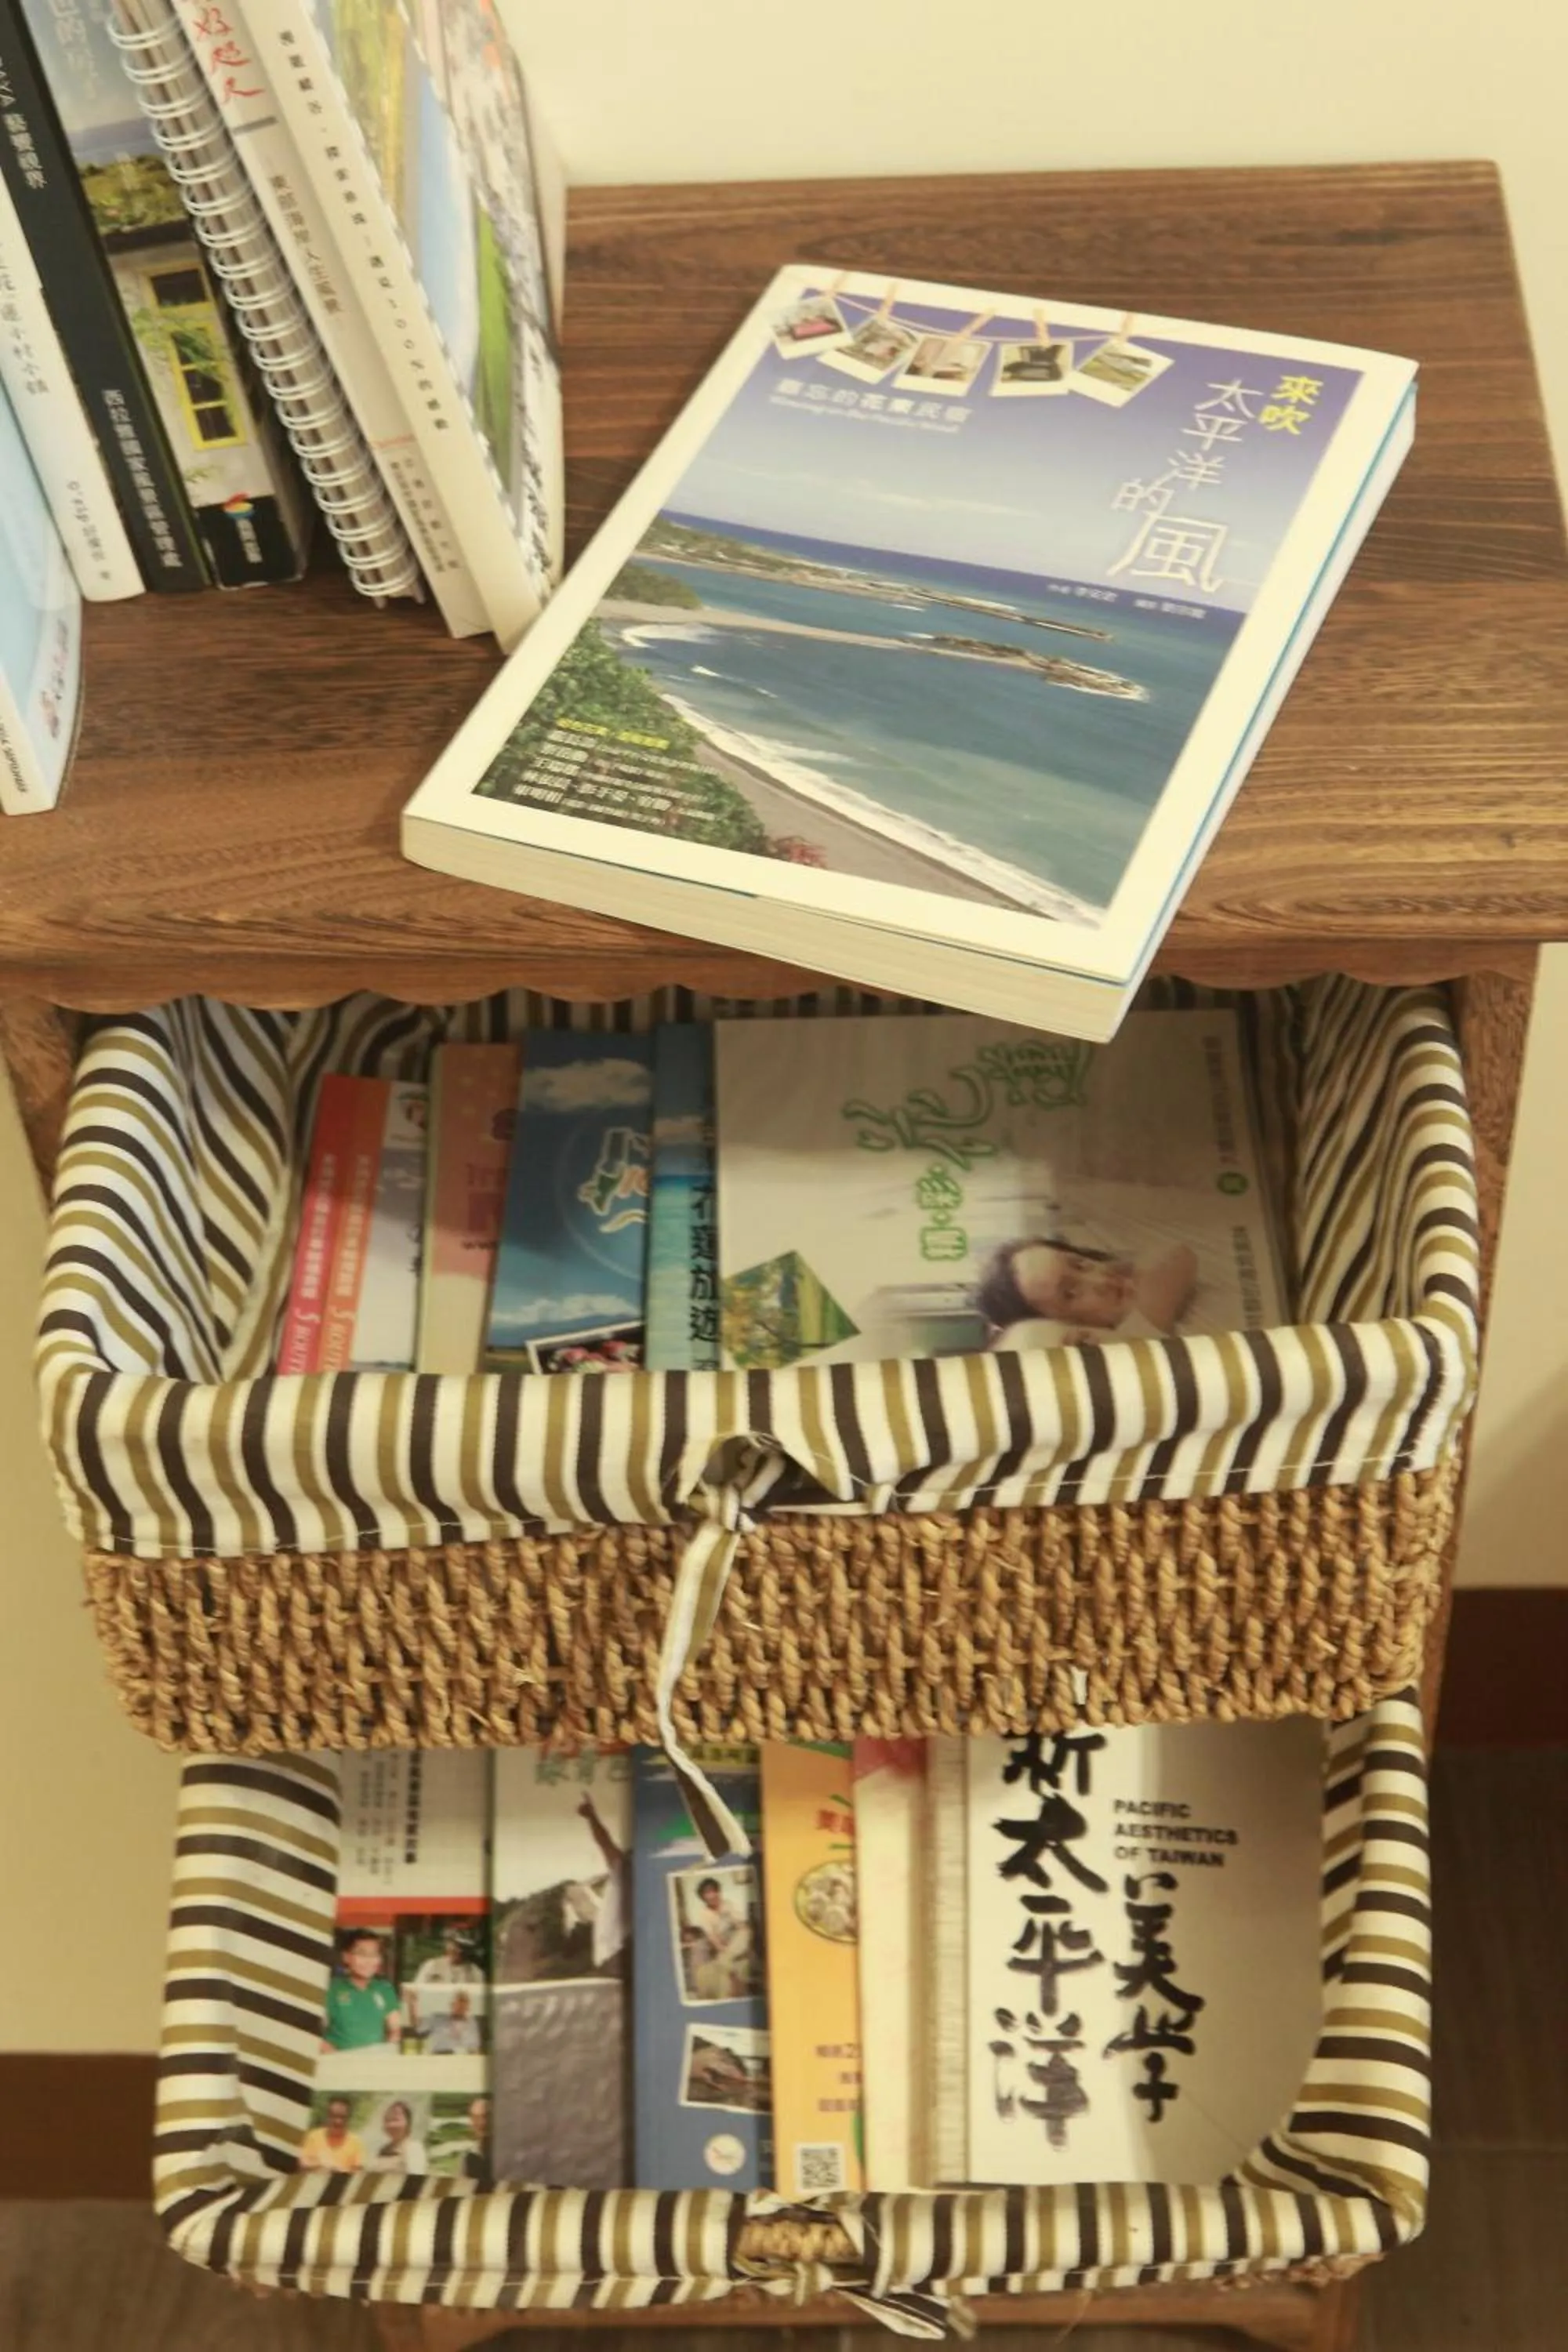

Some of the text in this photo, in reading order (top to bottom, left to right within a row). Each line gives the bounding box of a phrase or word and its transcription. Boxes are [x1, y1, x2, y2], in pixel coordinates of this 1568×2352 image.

[1258, 375, 1325, 435] 來吹
[1106, 378, 1264, 593] 太平洋的風
[1113, 1798, 1192, 1819] PACIFIC
[1114, 1823, 1239, 1845] AESTHETICS
[1114, 1846, 1226, 1868] OF TAIWAN
[989, 1729, 1110, 2151] 新太平洋
